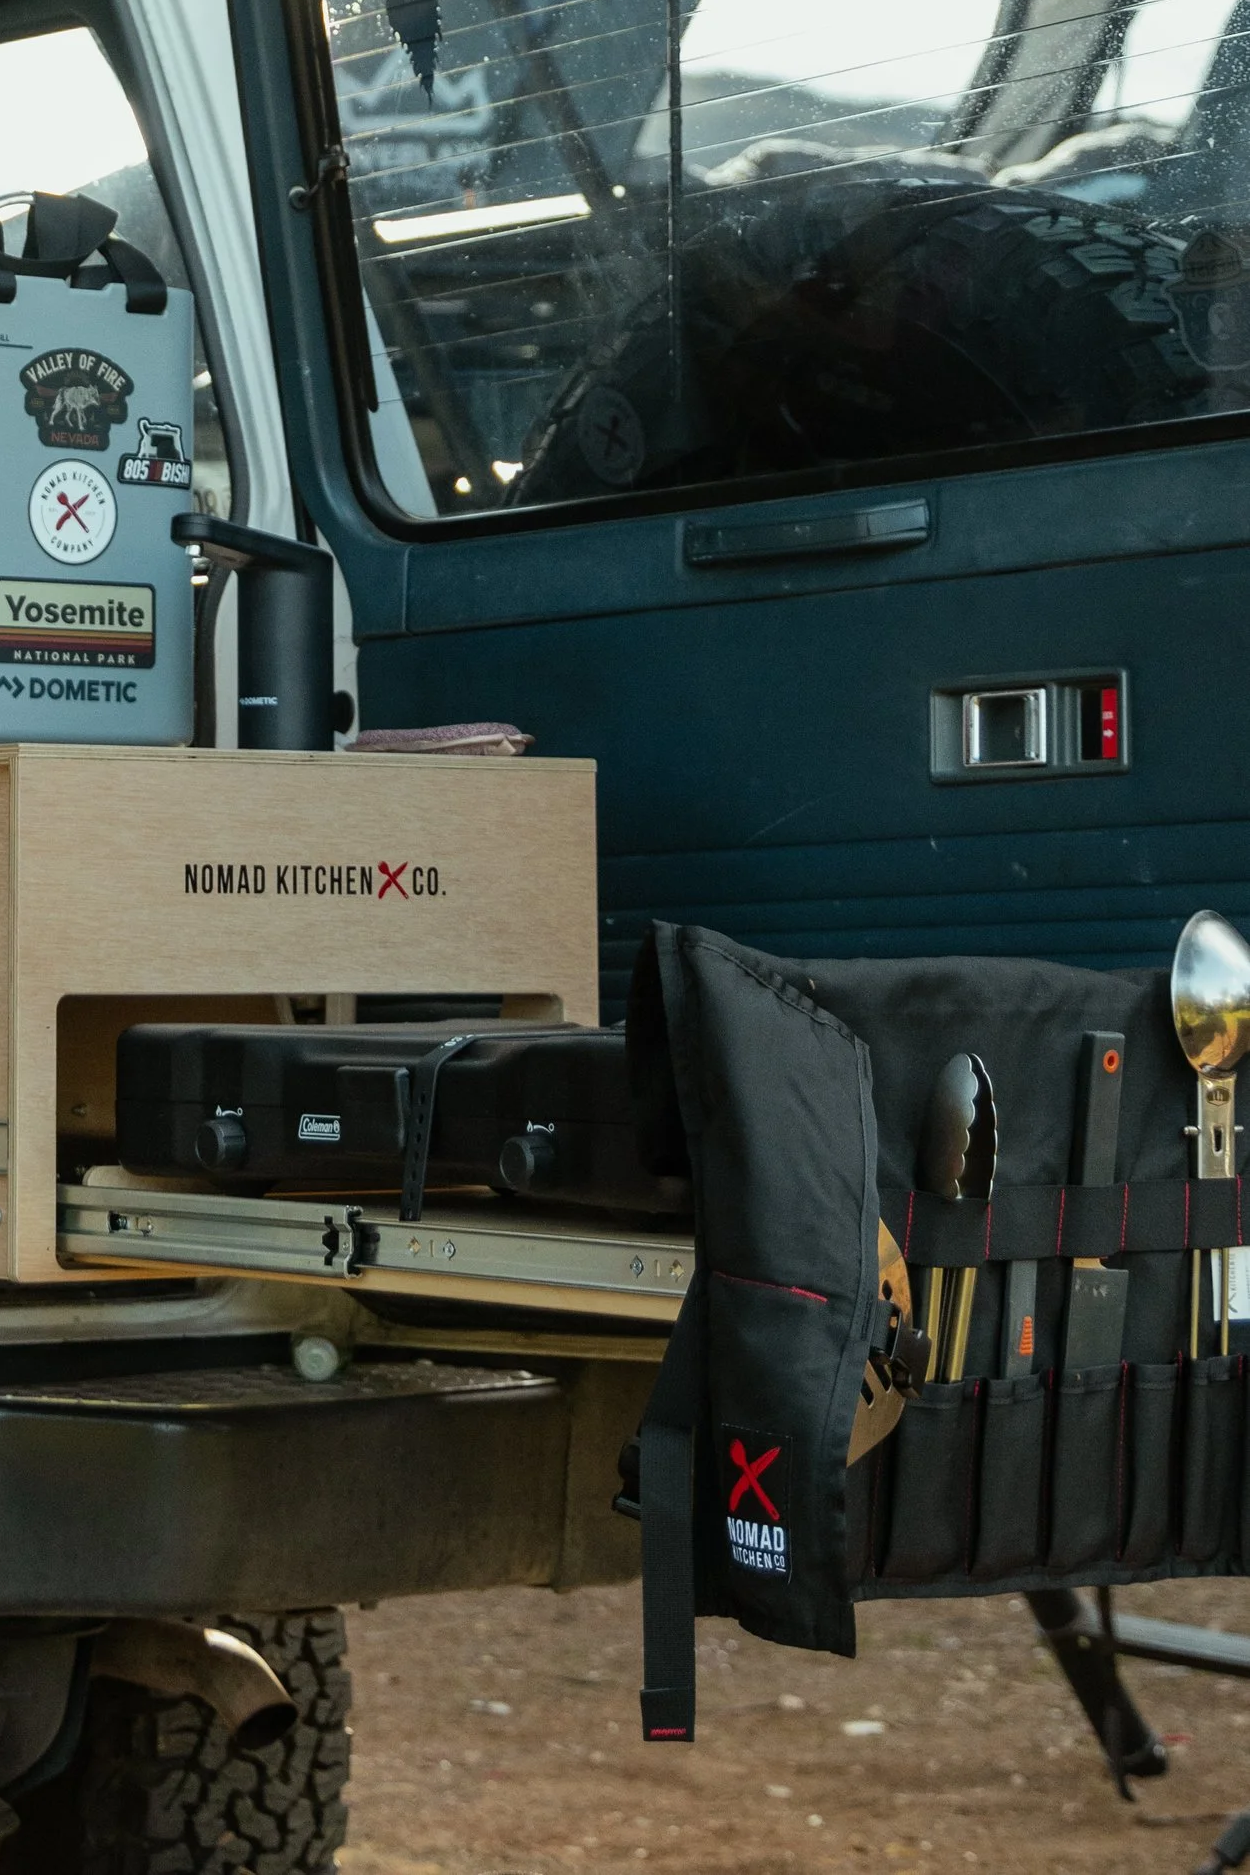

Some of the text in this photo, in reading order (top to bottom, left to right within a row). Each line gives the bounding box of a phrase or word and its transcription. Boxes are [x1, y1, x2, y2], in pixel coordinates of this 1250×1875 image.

[26, 352, 126, 392] VALLEY OF FIRE
[51, 431, 99, 446] NEVADA
[123, 458, 150, 480] 805
[41, 470, 106, 505] NOMAD KITCHEN
[50, 535, 94, 553] COMPANY
[4, 594, 145, 627] Yosemite
[13, 649, 136, 665] NATIONAL PARK
[29, 677, 138, 703] DOMETIC
[184, 863, 447, 896] NOMAD KITCHEN CO.
[302, 1117, 333, 1134] Coleman
[727, 1516, 785, 1552] NOMAD
[732, 1544, 785, 1569] KITCHEN CO
